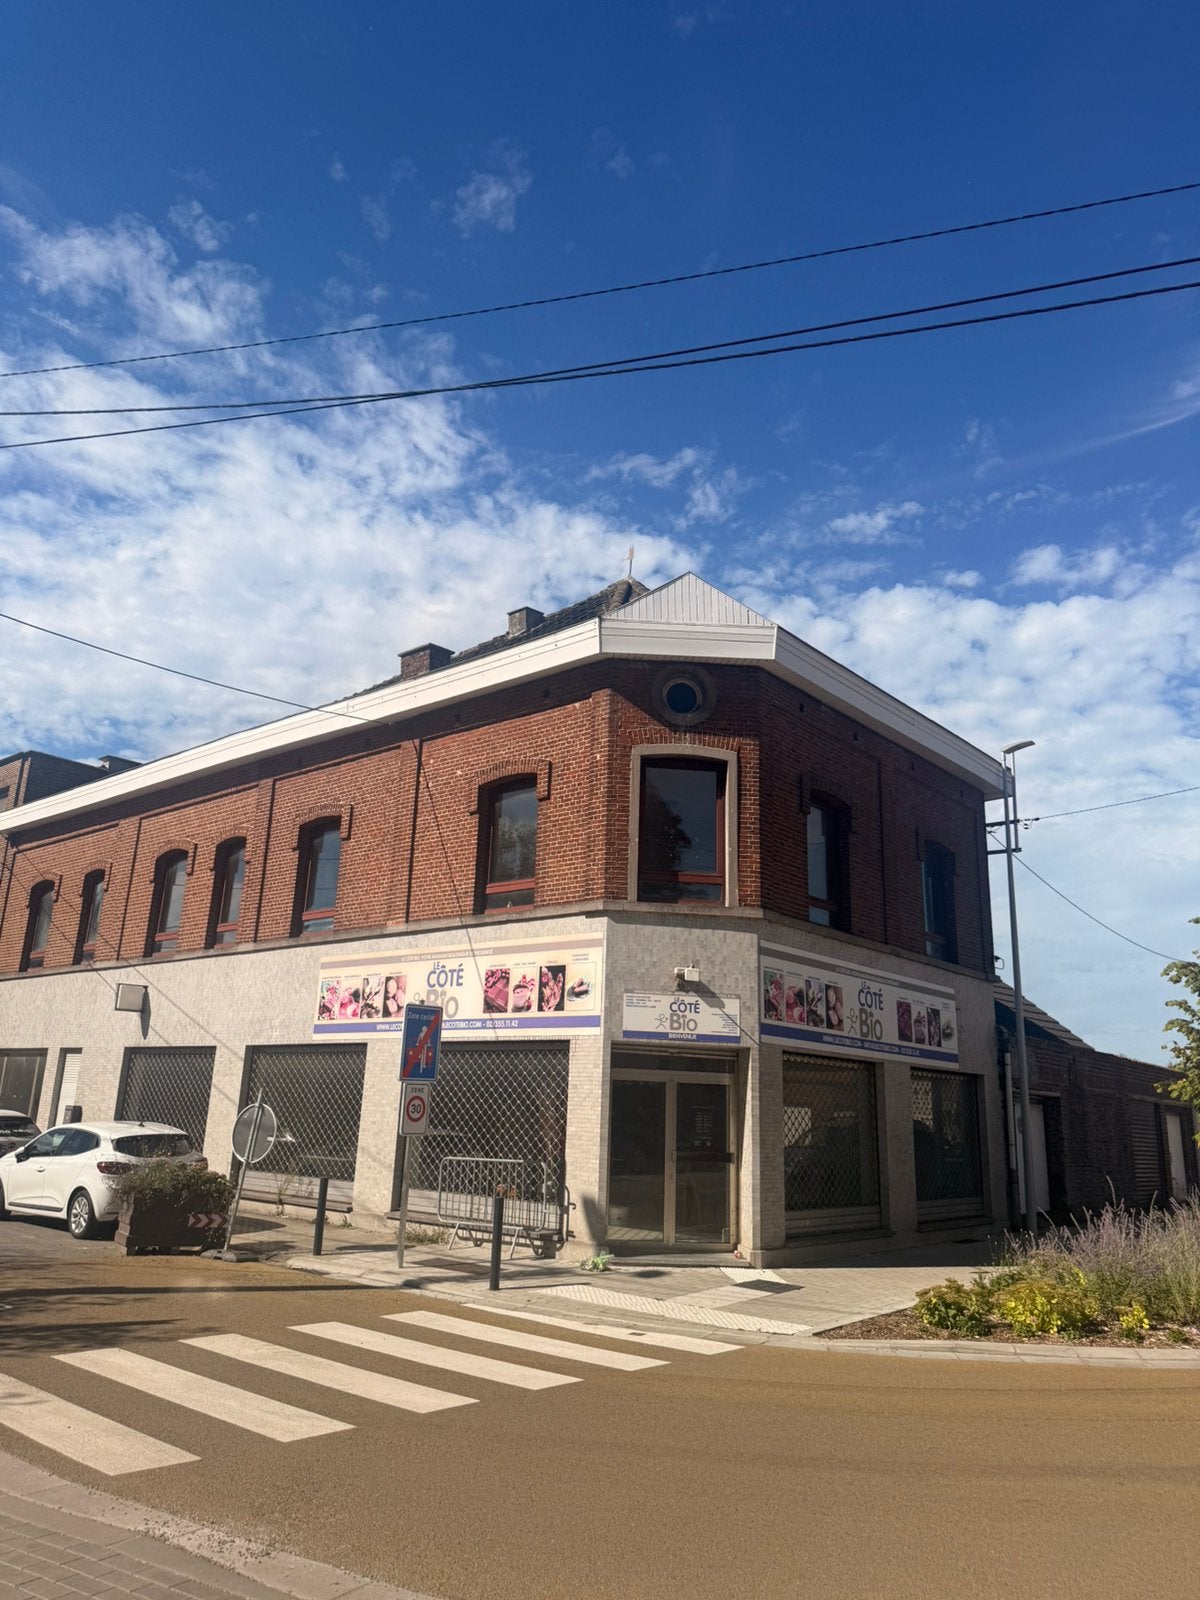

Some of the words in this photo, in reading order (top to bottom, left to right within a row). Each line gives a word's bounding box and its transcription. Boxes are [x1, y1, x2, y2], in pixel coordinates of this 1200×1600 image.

[433, 962, 440, 970] LE
[427, 963, 464, 988] CÔTÉ
[861, 981, 867, 990] LE
[858, 986, 884, 1011] CÔTÉ
[669, 999, 701, 1014] CÔTÉ
[376, 1023, 402, 1031] WWW.LECO
[411, 1104, 422, 1114] 30
